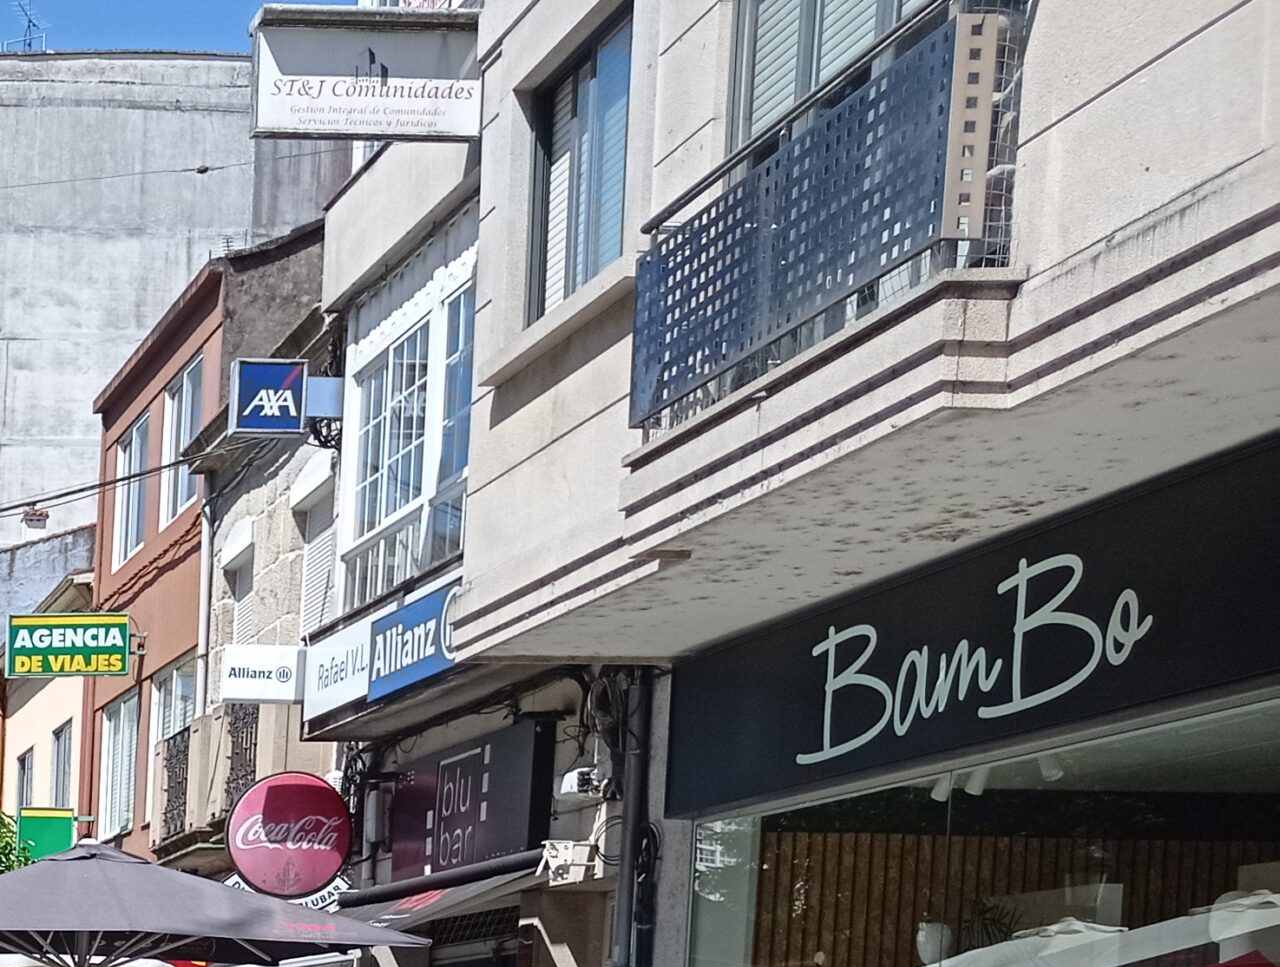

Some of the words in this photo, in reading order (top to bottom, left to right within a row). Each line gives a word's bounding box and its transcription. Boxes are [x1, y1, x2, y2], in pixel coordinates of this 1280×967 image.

[271, 78, 325, 99] ST&J
[332, 79, 475, 100] Comunidades
[242, 388, 298, 417] AXA
[13, 627, 125, 648] AGENCIA
[371, 618, 437, 682] Allianz
[15, 655, 43, 673] DE
[48, 654, 123, 672] VIAJES
[228, 667, 273, 680] Allianz
[316, 650, 349, 691] Rafael
[441, 767, 472, 818] blu
[439, 821, 473, 866] bar
